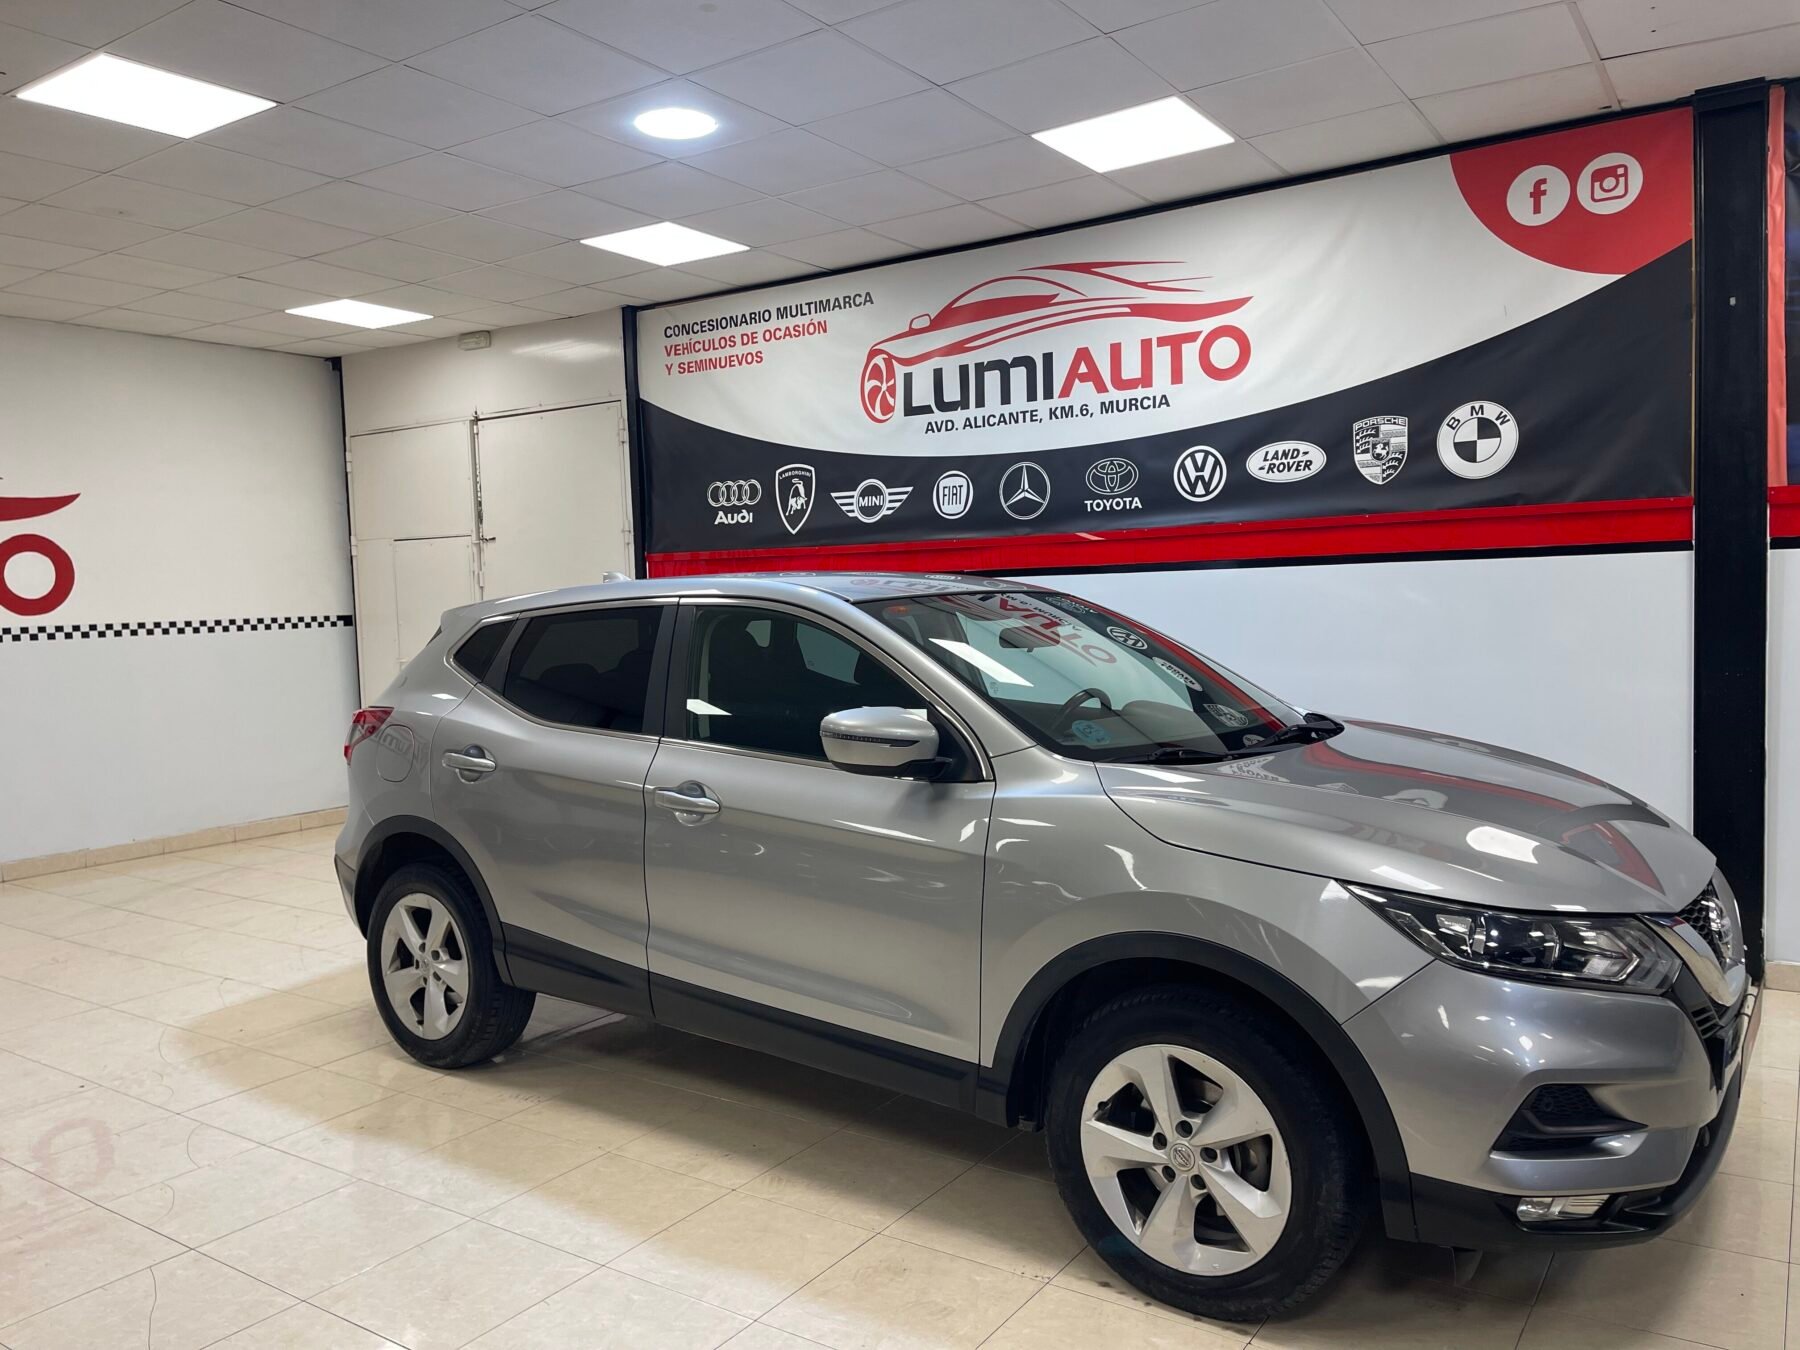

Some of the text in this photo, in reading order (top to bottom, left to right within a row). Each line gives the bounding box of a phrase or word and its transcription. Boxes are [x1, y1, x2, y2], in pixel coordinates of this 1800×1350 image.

[664, 291, 875, 339] CONCESIONARIO MULTIMARCA
[664, 319, 828, 358] VEHÍCULOS DE OCASIÓN
[665, 350, 764, 376] Y SEMINUEVOS
[924, 394, 1171, 435] AVD. ALICANTE, KM.6, MURCIA
[1354, 417, 1406, 431] PORSCHE
[1446, 404, 1511, 431] BMW
[858, 494, 885, 508] MINI
[942, 484, 965, 507] FIAT
[1084, 496, 1143, 512] TOYOTA
[714, 509, 753, 525] Audi
